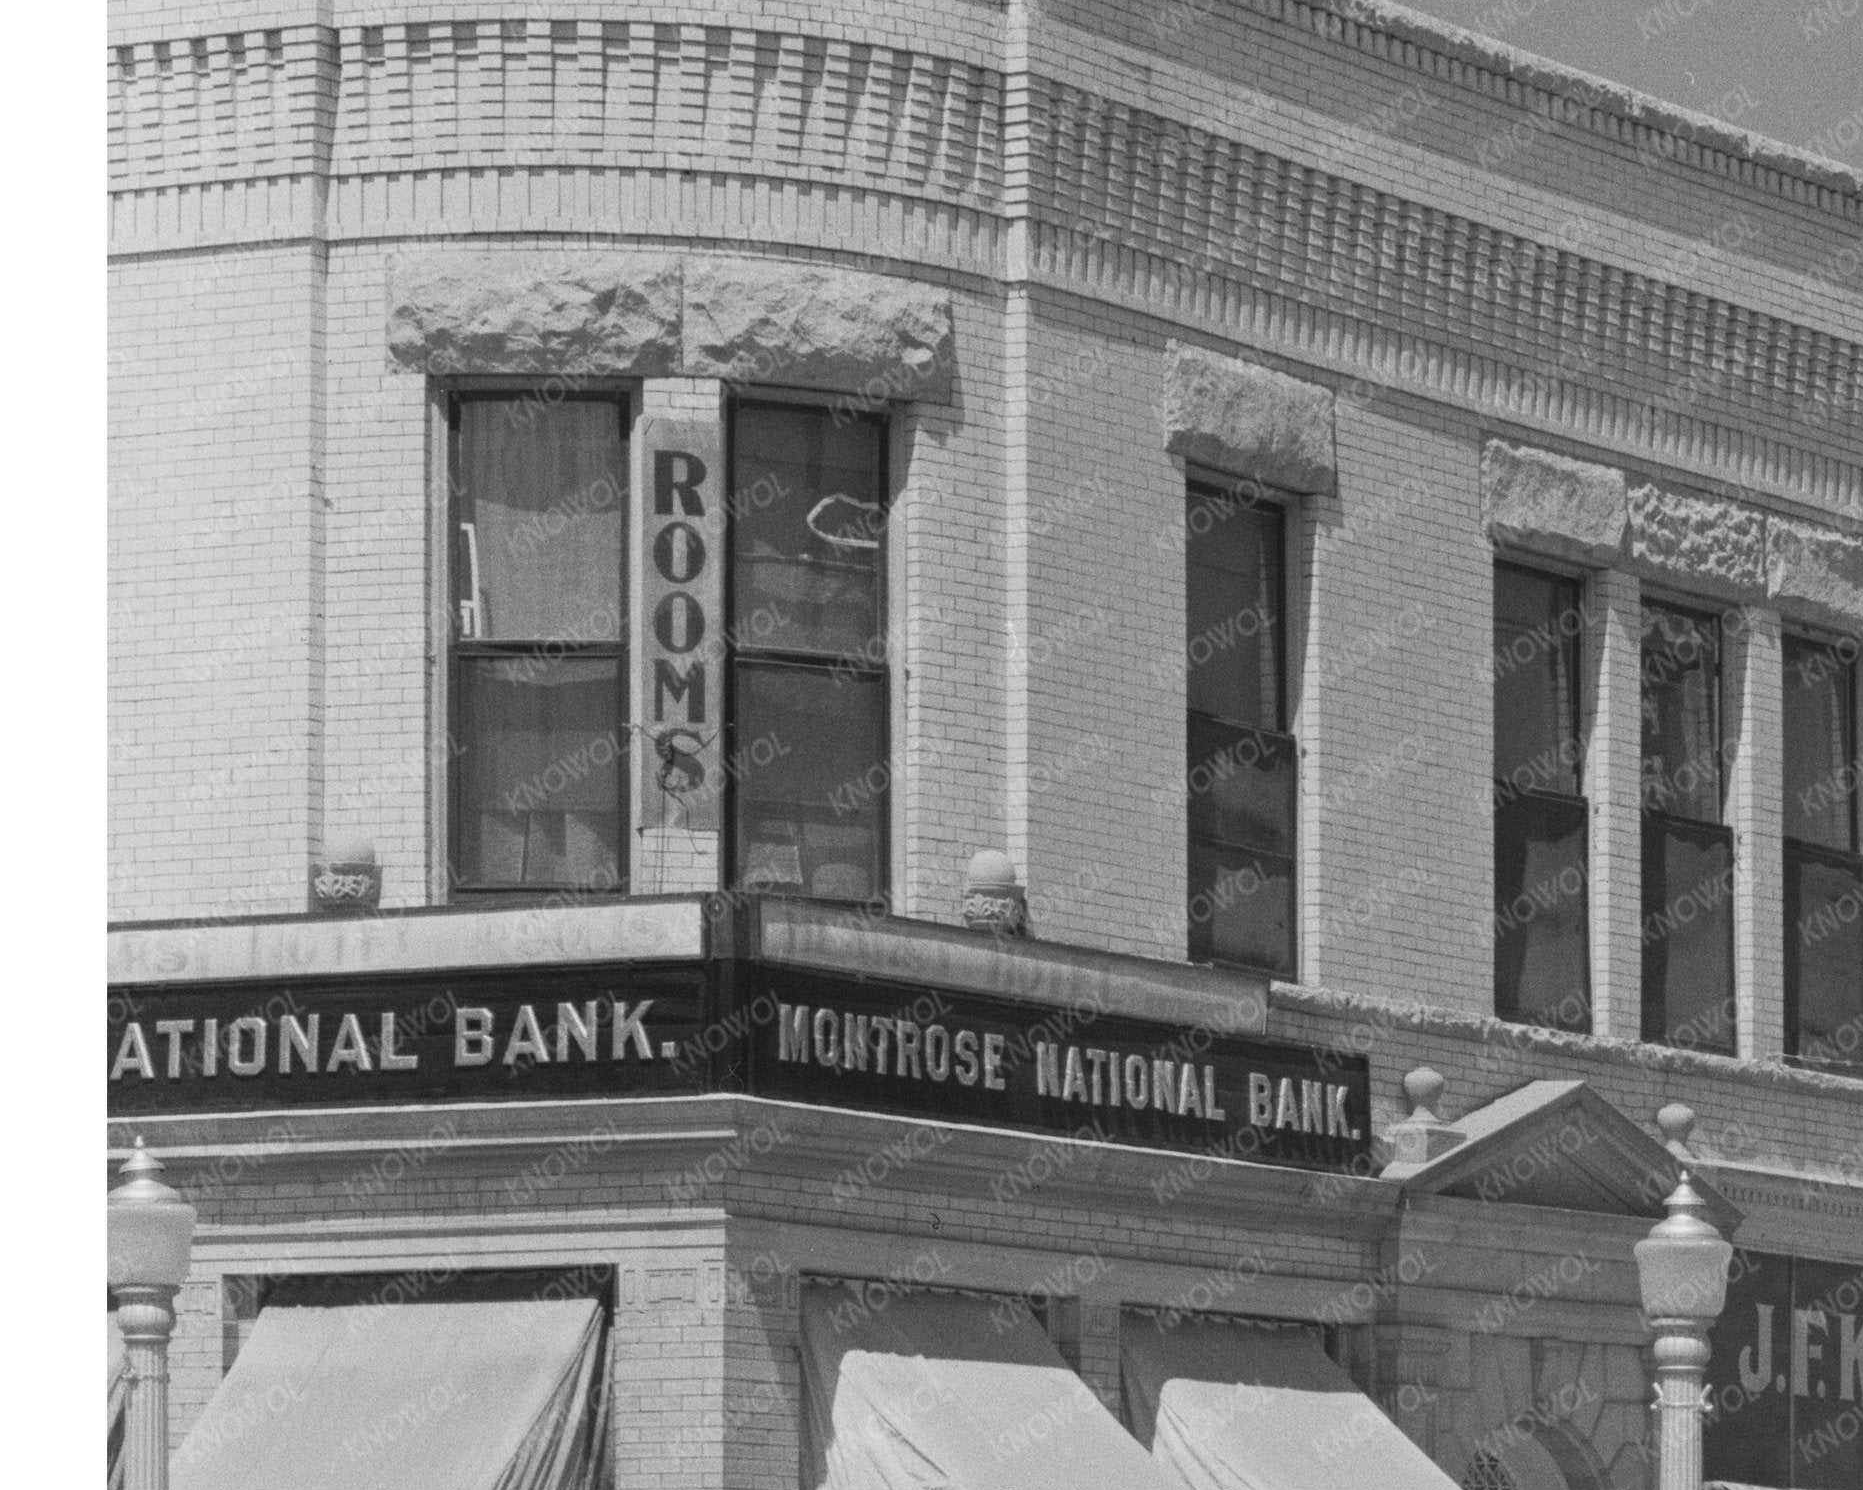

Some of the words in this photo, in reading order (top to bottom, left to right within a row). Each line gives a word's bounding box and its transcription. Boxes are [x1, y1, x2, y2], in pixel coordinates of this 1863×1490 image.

[653, 449, 708, 793] ROOMS
[109, 1011, 419, 1081] ATIONAL
[453, 999, 676, 1067] BANK.
[778, 1003, 1006, 1091] MONTROSE
[1036, 1040, 1227, 1122] NATIONAL
[1248, 1071, 1361, 1141] BANK.
